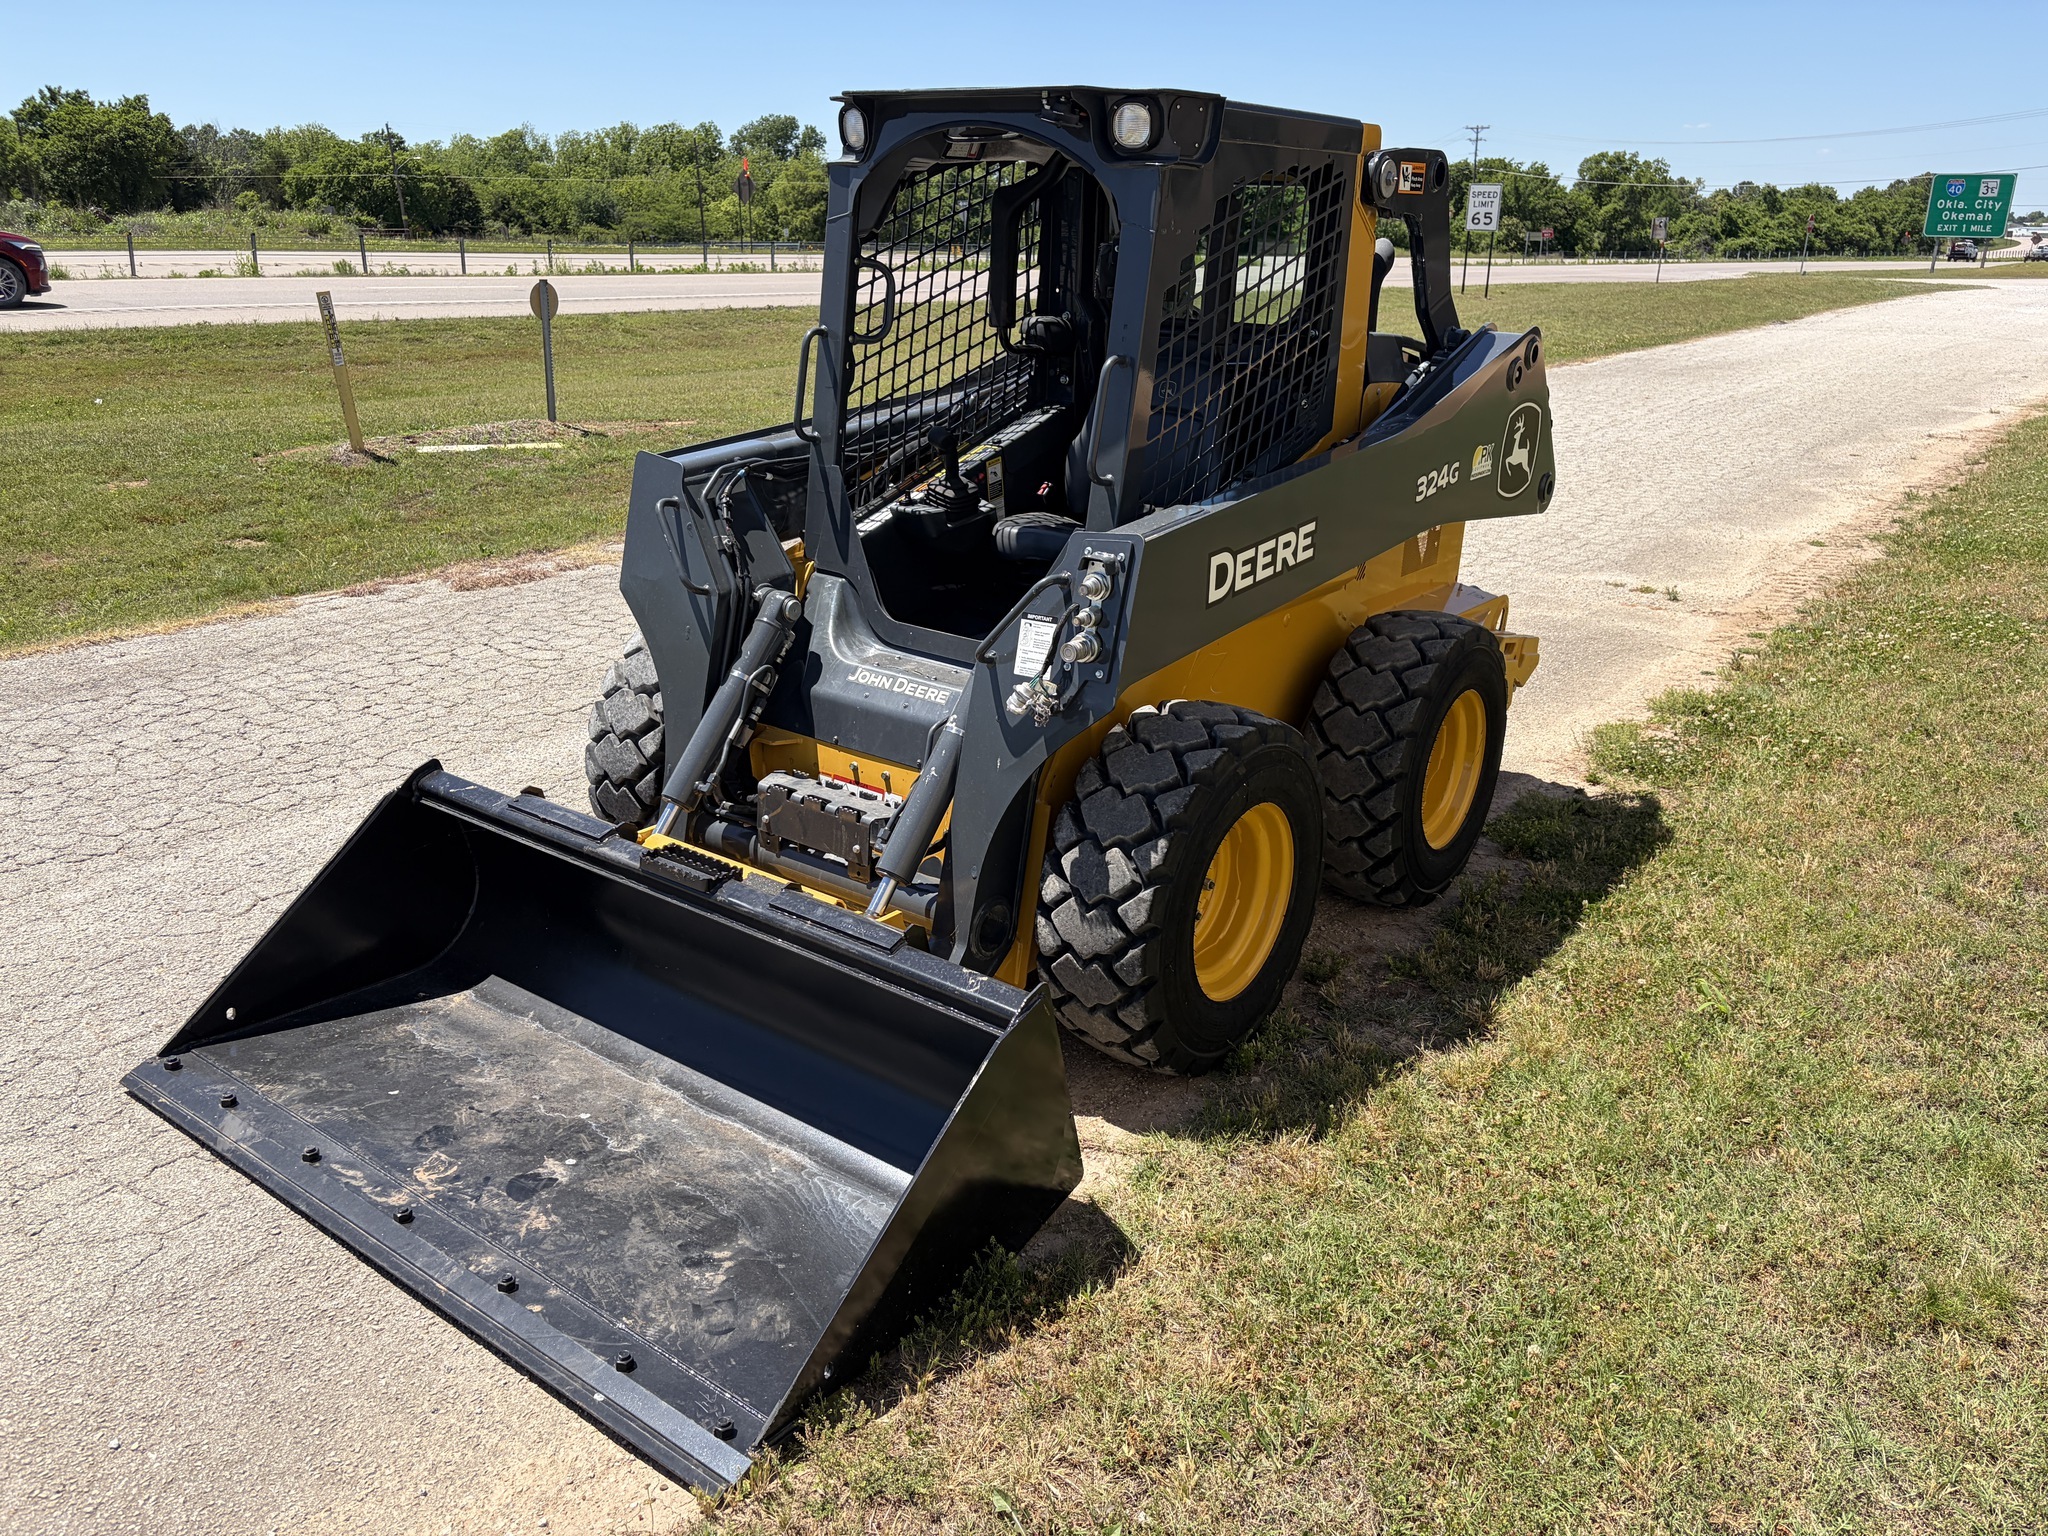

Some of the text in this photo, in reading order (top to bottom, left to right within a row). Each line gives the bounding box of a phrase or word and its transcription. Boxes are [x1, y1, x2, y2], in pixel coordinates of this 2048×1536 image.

[1471, 190, 1498, 199] SPEED
[1948, 185, 1963, 194] 40
[1472, 200, 1494, 208] LIMIT
[1937, 199, 2002, 211] Okla. City
[1471, 212, 1493, 226] 65
[1942, 211, 1992, 221] Okemah
[1937, 224, 1958, 232] EXIT
[1415, 461, 1460, 502] 324G
[1207, 521, 1317, 604] DEERE
[1027, 613, 1053, 622] IMPORTANT
[847, 667, 951, 703] JOHN DEERE
